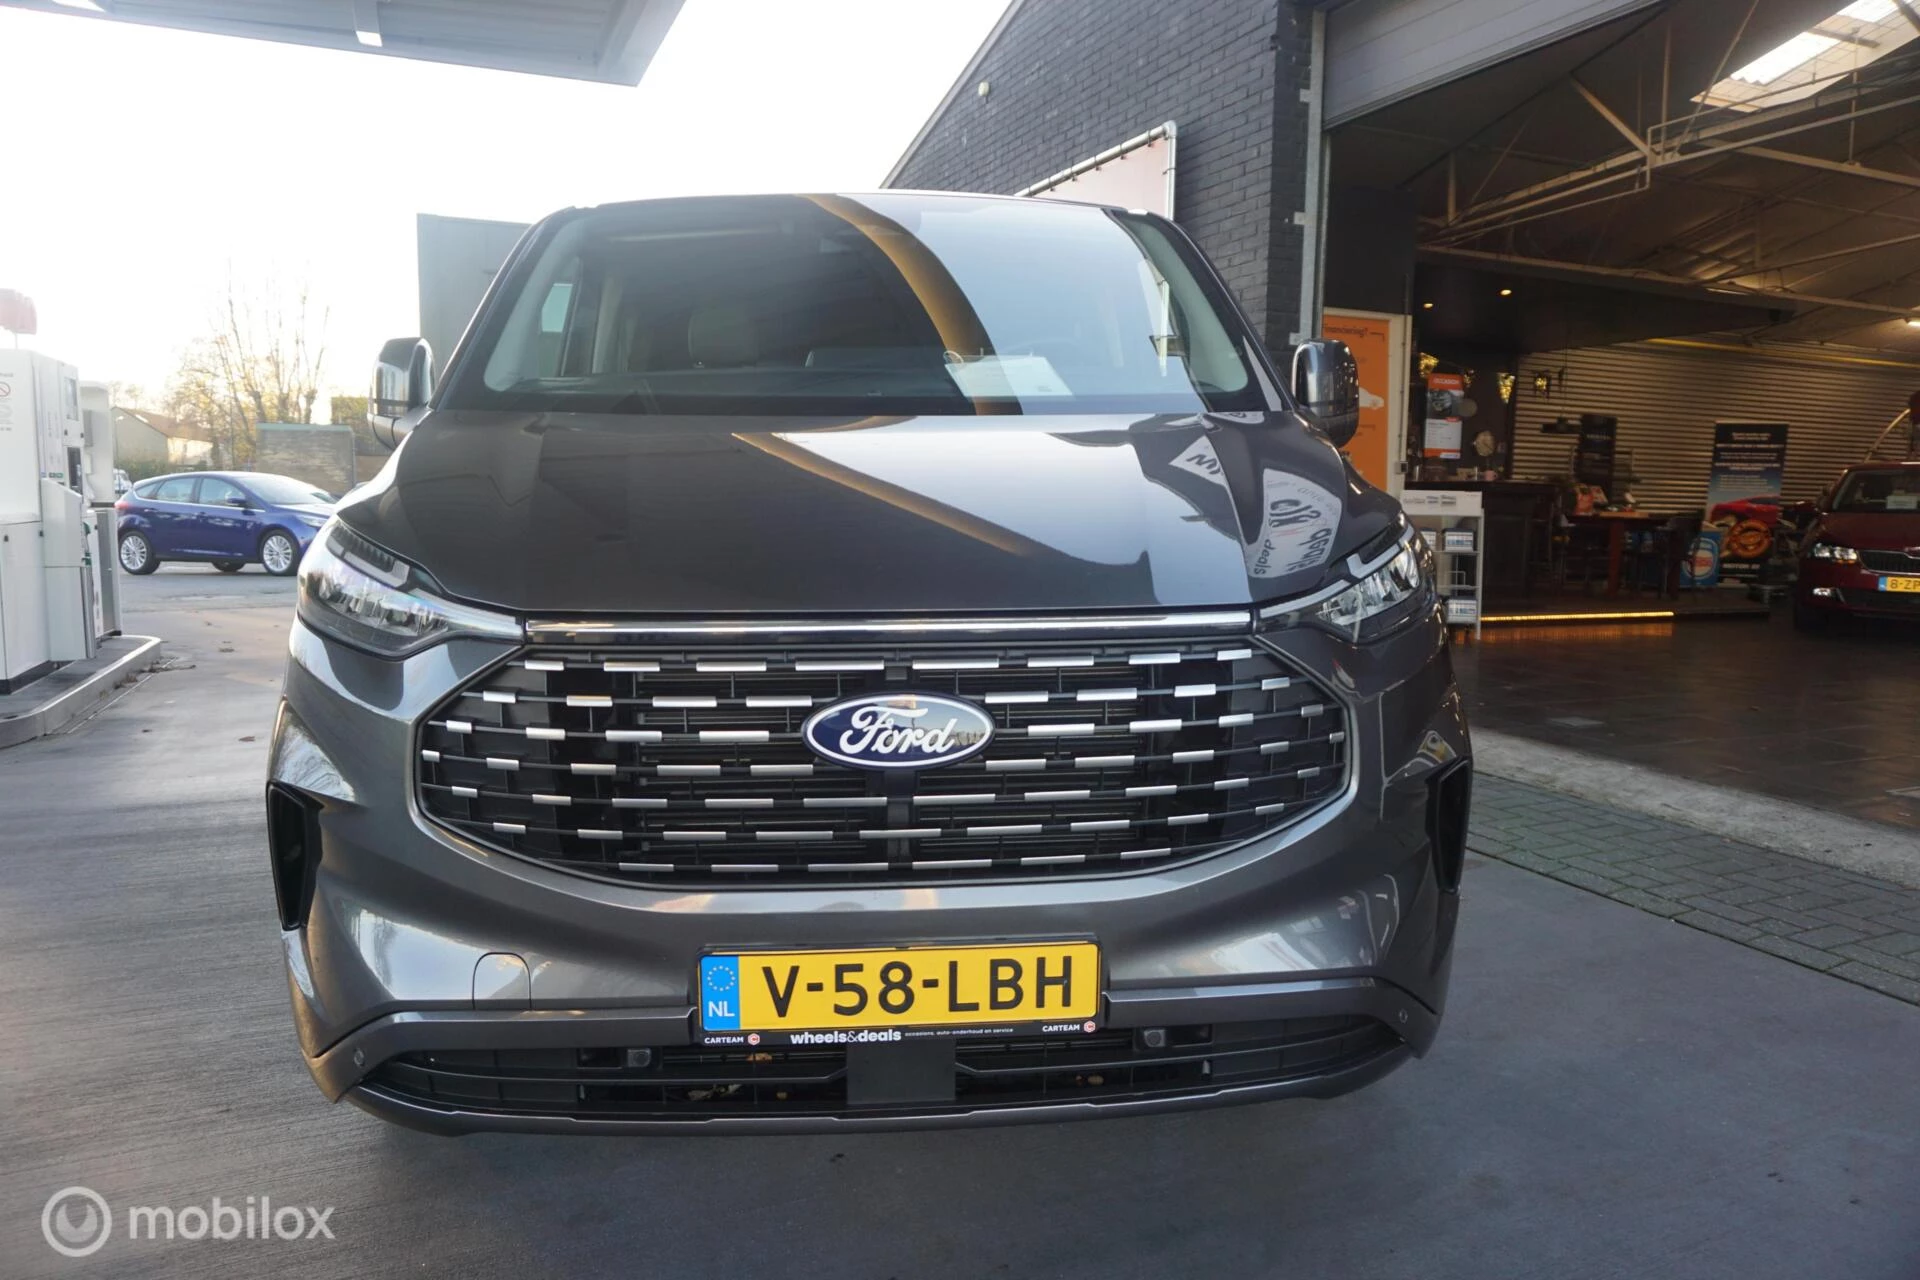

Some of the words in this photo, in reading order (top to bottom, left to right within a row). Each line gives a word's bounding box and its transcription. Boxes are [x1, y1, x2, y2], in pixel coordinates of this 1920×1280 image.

[839, 706, 957, 754] Ford
[762, 955, 1072, 1018] V-58-LBH
[708, 1001, 735, 1018] NL
[1042, 1023, 1080, 1033] CARTEAM
[704, 1036, 744, 1045] CARTEAM
[790, 1029, 901, 1045] wheels&deals
